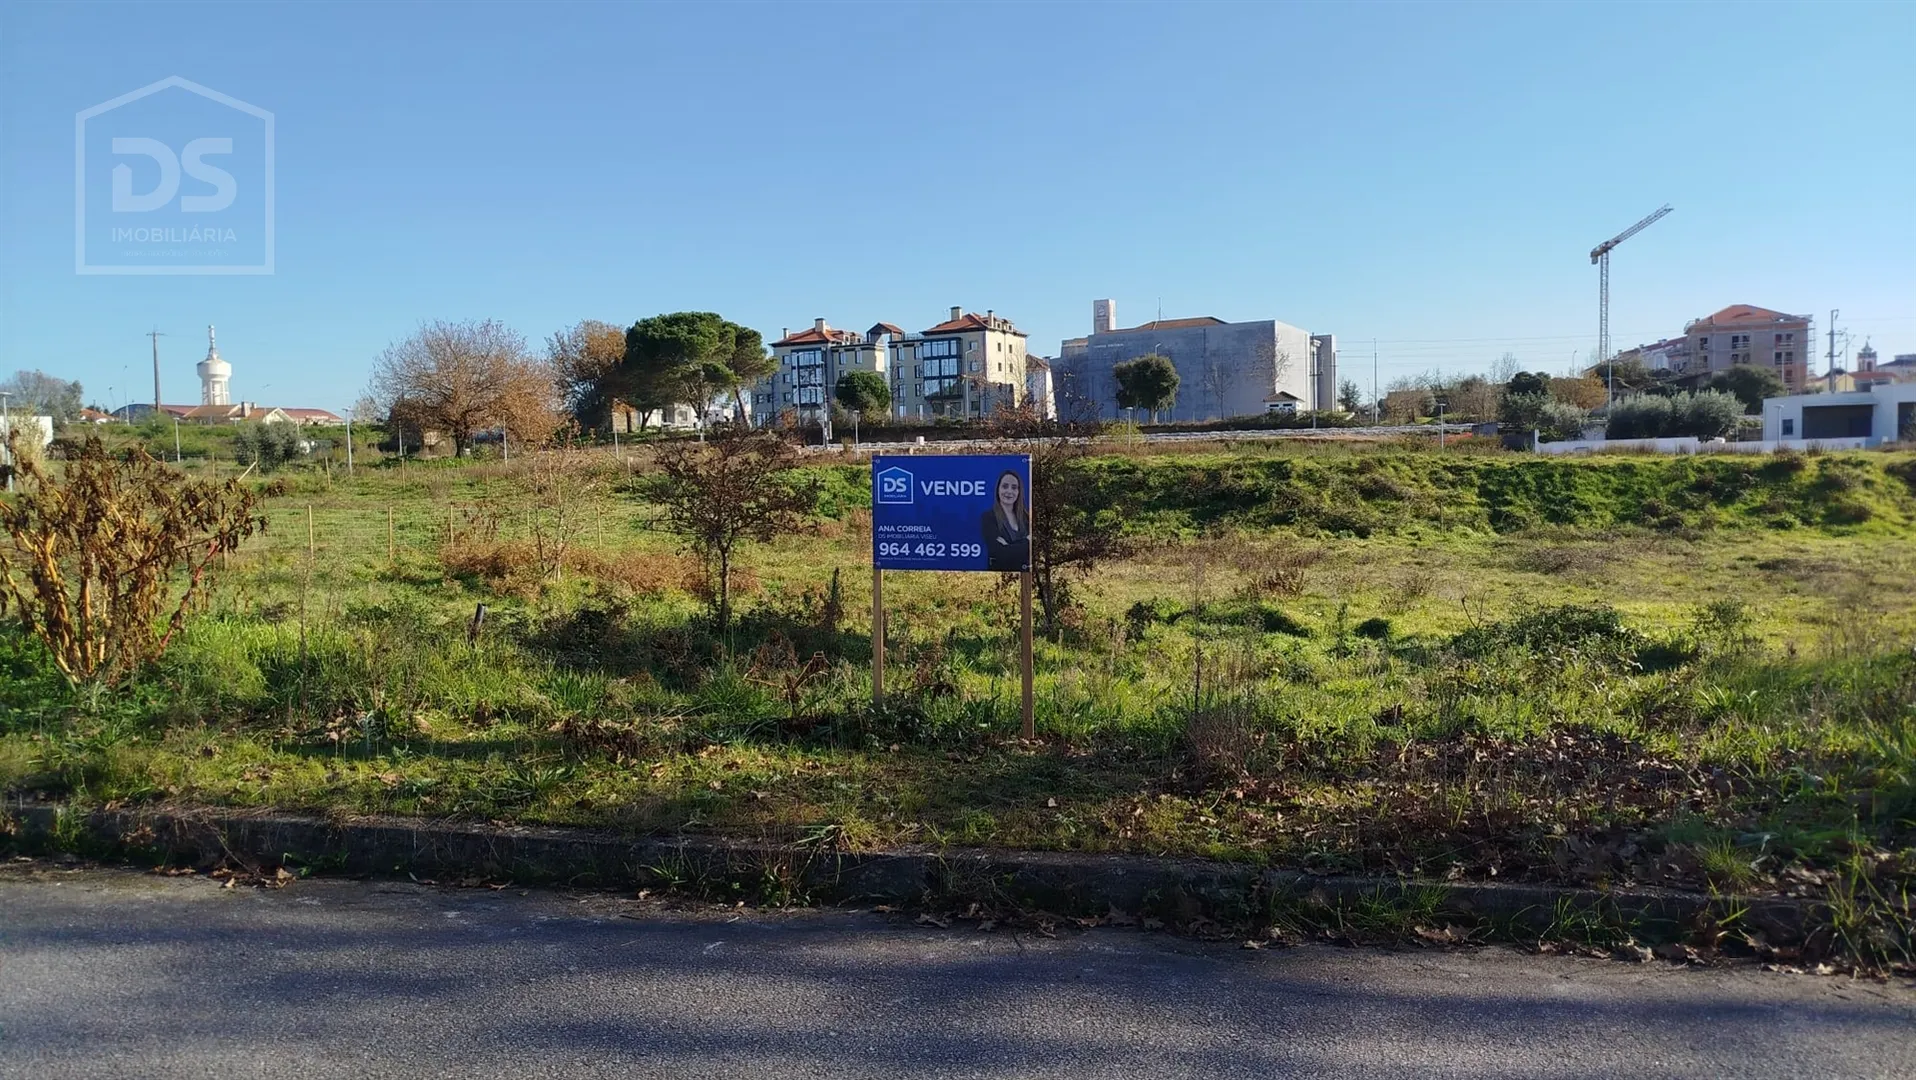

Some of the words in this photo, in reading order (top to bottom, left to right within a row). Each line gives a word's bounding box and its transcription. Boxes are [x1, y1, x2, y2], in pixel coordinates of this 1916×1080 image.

[884, 477, 907, 493] DS
[921, 481, 986, 495] VENDE
[879, 542, 910, 556] 964
[914, 543, 945, 556] 462
[950, 544, 981, 557] 599
